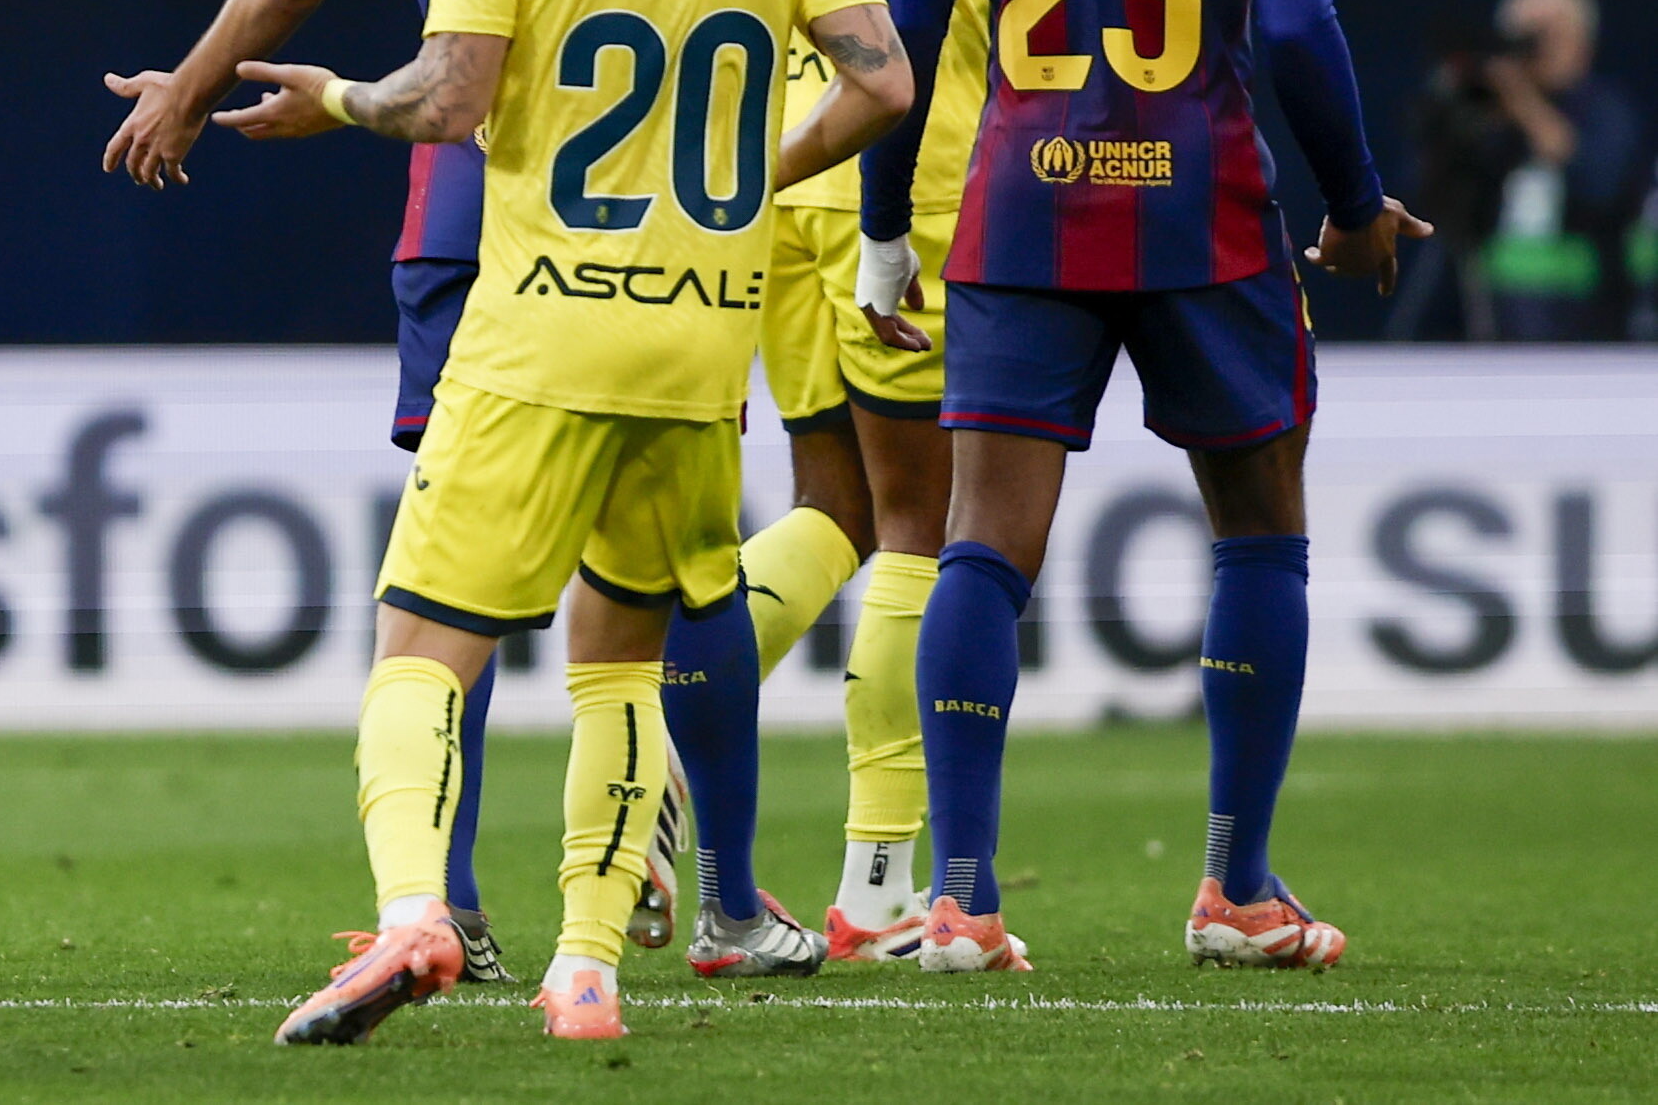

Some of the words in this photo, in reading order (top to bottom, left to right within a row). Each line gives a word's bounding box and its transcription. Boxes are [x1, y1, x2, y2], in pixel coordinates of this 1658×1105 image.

[550, 8, 776, 234] 20
[1089, 140, 1172, 159] UNHCR
[1089, 159, 1172, 178] ACNUR
[515, 255, 763, 310] ASCALE
